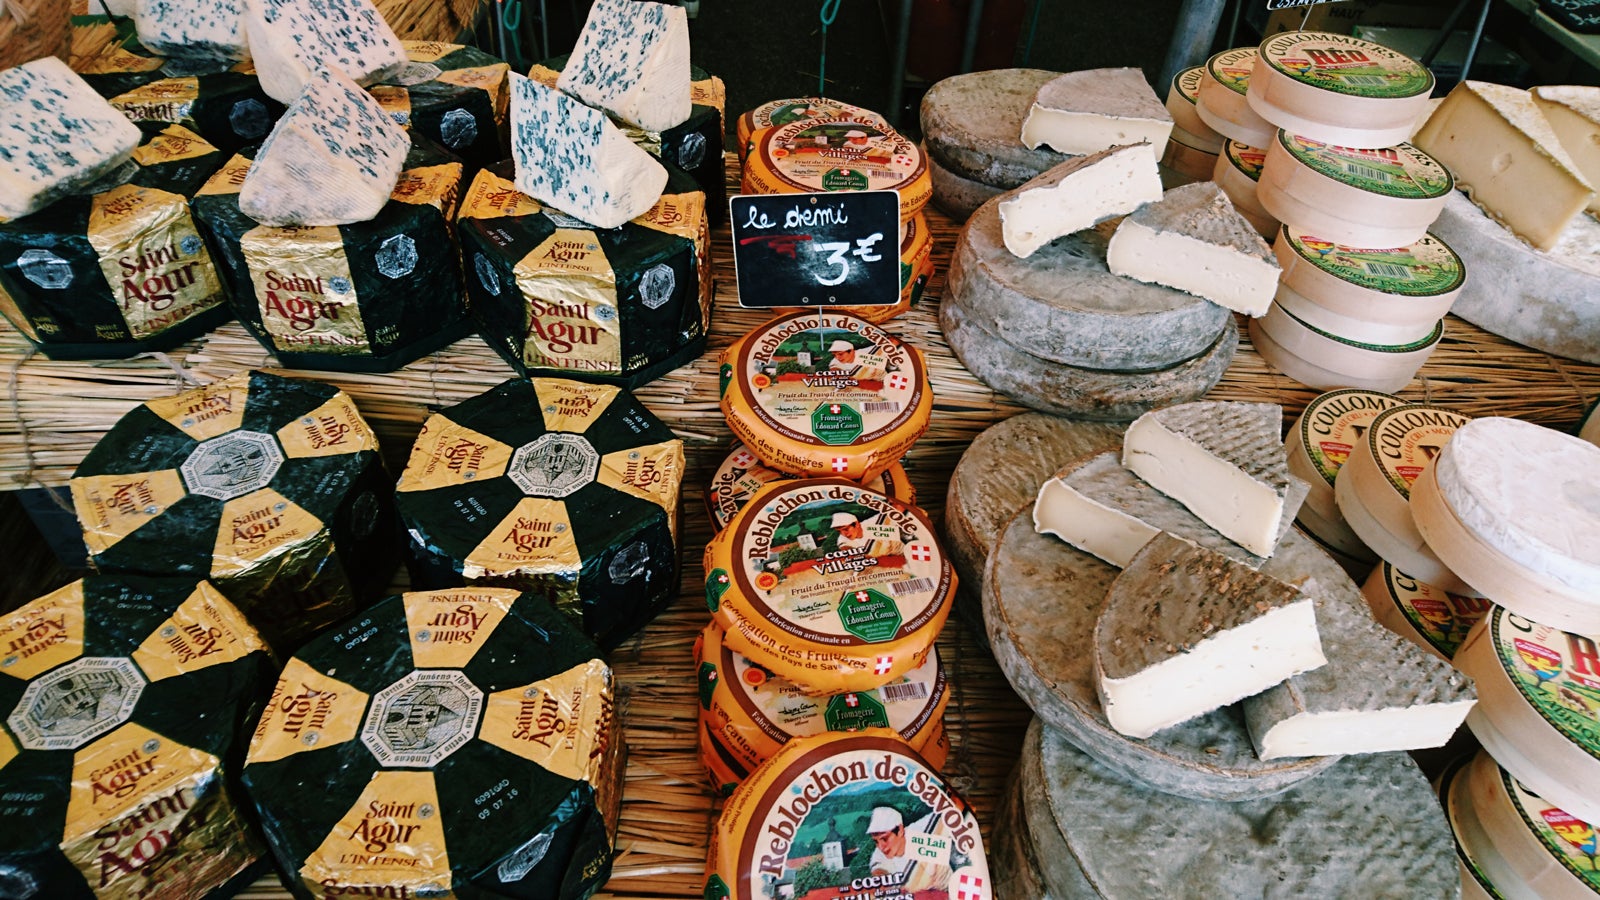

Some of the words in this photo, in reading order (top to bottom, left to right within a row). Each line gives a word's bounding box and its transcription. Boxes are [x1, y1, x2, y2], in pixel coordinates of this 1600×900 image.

[1269, 34, 1394, 59] COULOMMIERS
[1302, 47, 1370, 65] RÉO
[775, 116, 850, 144] Reblochon
[853, 116, 873, 126] de
[873, 123, 912, 151] Savoie
[818, 151, 868, 161] Villages
[743, 205, 777, 229] le
[784, 202, 849, 229] demi
[543, 247, 591, 263] Agur
[551, 238, 586, 251] Saint
[119, 244, 180, 278] Saint
[122, 261, 199, 311] Agur
[266, 269, 323, 296] Saint
[265, 290, 345, 331] Agur
[531, 299, 591, 321] Saint
[526, 317, 608, 354] Agur
[752, 317, 831, 364] Reblochon
[836, 316, 858, 332] de
[860, 326, 904, 365] Savoie
[868, 354, 884, 363] Lait
[801, 378, 859, 389] Villages
[553, 395, 600, 408] Agur
[556, 406, 590, 418] Saint
[1313, 396, 1396, 436] COULOM
[304, 423, 326, 451] Saint
[318, 415, 349, 446] Agur
[1380, 412, 1467, 459] COULOMM
[444, 438, 476, 475] Agur
[467, 443, 489, 472] Saint
[757, 439, 774, 453] des
[621, 457, 640, 487] Saint
[634, 456, 662, 494] Agur
[111, 482, 137, 516] Agur
[231, 513, 286, 546] Agur
[232, 506, 272, 528] Saint
[515, 516, 552, 532] Saint
[749, 489, 824, 559] Reblochon
[828, 487, 854, 501] de
[857, 492, 919, 535] Savoie
[878, 525, 896, 533] Lait
[502, 529, 558, 553] Agur
[825, 546, 865, 560] cœur
[811, 557, 878, 575] Villages
[791, 587, 813, 596] Fruit
[814, 583, 826, 591] du
[826, 576, 857, 588] Travail
[868, 569, 904, 580] commun
[428, 594, 493, 604] L'INTENSE
[847, 600, 886, 614] Fromagerie
[427, 604, 489, 630] Agur
[766, 611, 804, 637] Fabrication
[804, 632, 840, 644] artisanale
[903, 615, 929, 633] fruitière
[5, 613, 66, 655] Agur
[22, 630, 68, 659] Saint
[182, 623, 224, 659] Agur
[347, 626, 359, 636] 07
[433, 629, 477, 644] Saint
[169, 636, 197, 664] Saint
[762, 647, 779, 658] des
[781, 655, 802, 668] Pays
[805, 661, 818, 669] de
[778, 642, 802, 659] des
[280, 682, 325, 740] Agur
[308, 691, 337, 731] Saint
[512, 695, 536, 741] Saint
[529, 691, 567, 748] Agur
[835, 708, 875, 720] Fromagerie
[751, 710, 788, 743] Fabrication
[89, 748, 142, 783] Saint
[89, 753, 159, 804] Agur
[95, 786, 190, 850] Saint
[366, 800, 415, 820] Saint
[478, 809, 491, 821] 09
[492, 799, 505, 812] 07
[506, 788, 519, 800] 16
[759, 759, 868, 878] Reblochon
[875, 754, 907, 785] de
[909, 771, 975, 853] Savoie
[349, 817, 422, 854] Agur
[911, 836, 924, 845] au
[928, 836, 946, 849] Lait
[339, 852, 423, 868] L'INTENSE
[917, 846, 937, 858] Cru
[851, 872, 904, 890] cœur
[875, 889, 884, 897] de
